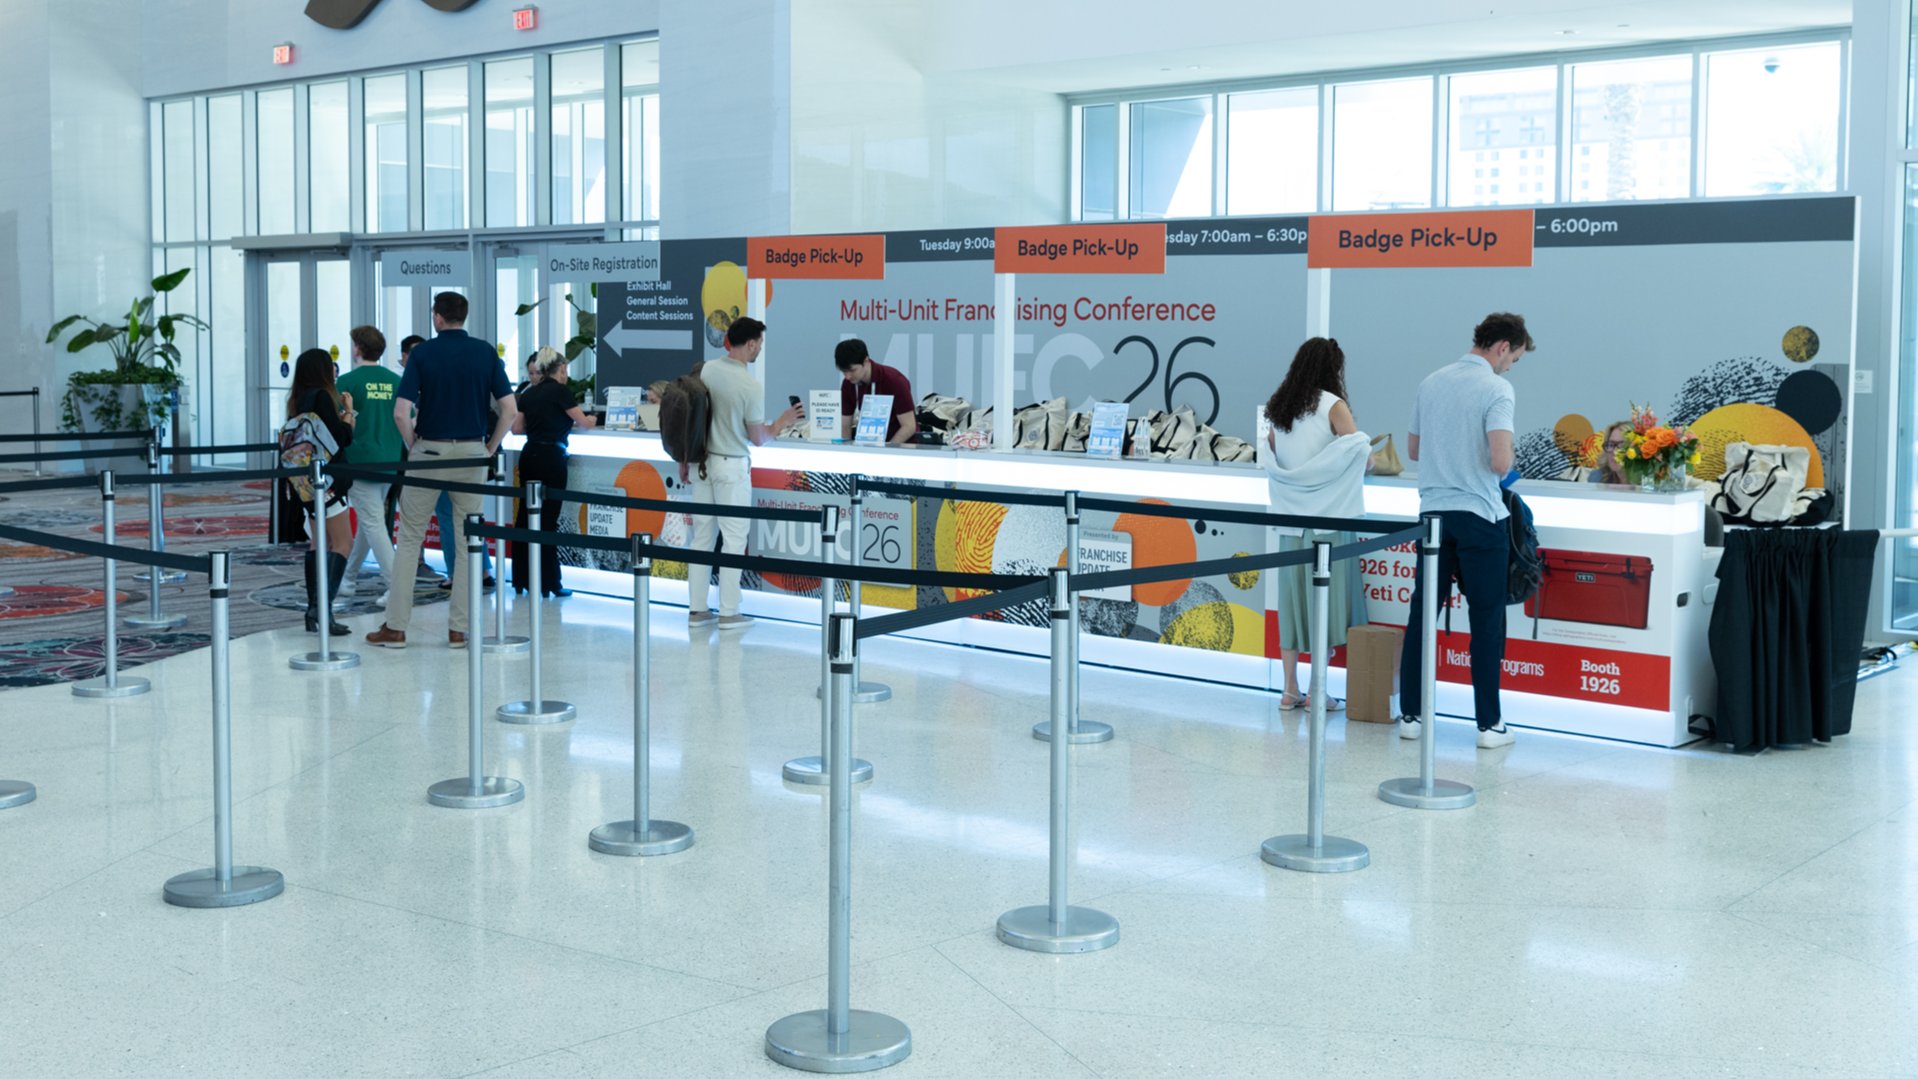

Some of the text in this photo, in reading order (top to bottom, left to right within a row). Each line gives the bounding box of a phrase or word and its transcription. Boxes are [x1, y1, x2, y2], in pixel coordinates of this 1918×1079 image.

[919, 239, 962, 253] Tuesday
[964, 237, 995, 250] 9:00a
[1201, 230, 1251, 243] 7:00am
[1267, 228, 1308, 244] 6:30p
[1550, 218, 1619, 236] 6:00pm
[1338, 227, 1498, 253] Badge Pick-Up
[1018, 238, 1139, 260] Badge Pick-Up
[550, 256, 658, 274] On-Site Registration
[766, 248, 864, 268] Badge Pick-Up
[400, 260, 452, 276] Questions
[627, 281, 672, 291] Exhibit Hall
[627, 296, 688, 306] General Session
[626, 311, 694, 321] Content Sessions
[840, 296, 1216, 327] Multi-Unit Francising Conference
[379, 383, 393, 391] THE
[367, 392, 393, 400] MONEY
[590, 513, 613, 524] UPDATE
[589, 525, 609, 536] MEDIA
[1083, 531, 1119, 541] Presented by
[1079, 547, 1128, 564] RANCHISE
[1079, 562, 1110, 575] PDAT
[1446, 648, 1544, 677] Natio rograms
[1580, 660, 1620, 676] Booth
[1580, 676, 1620, 695] 1926
